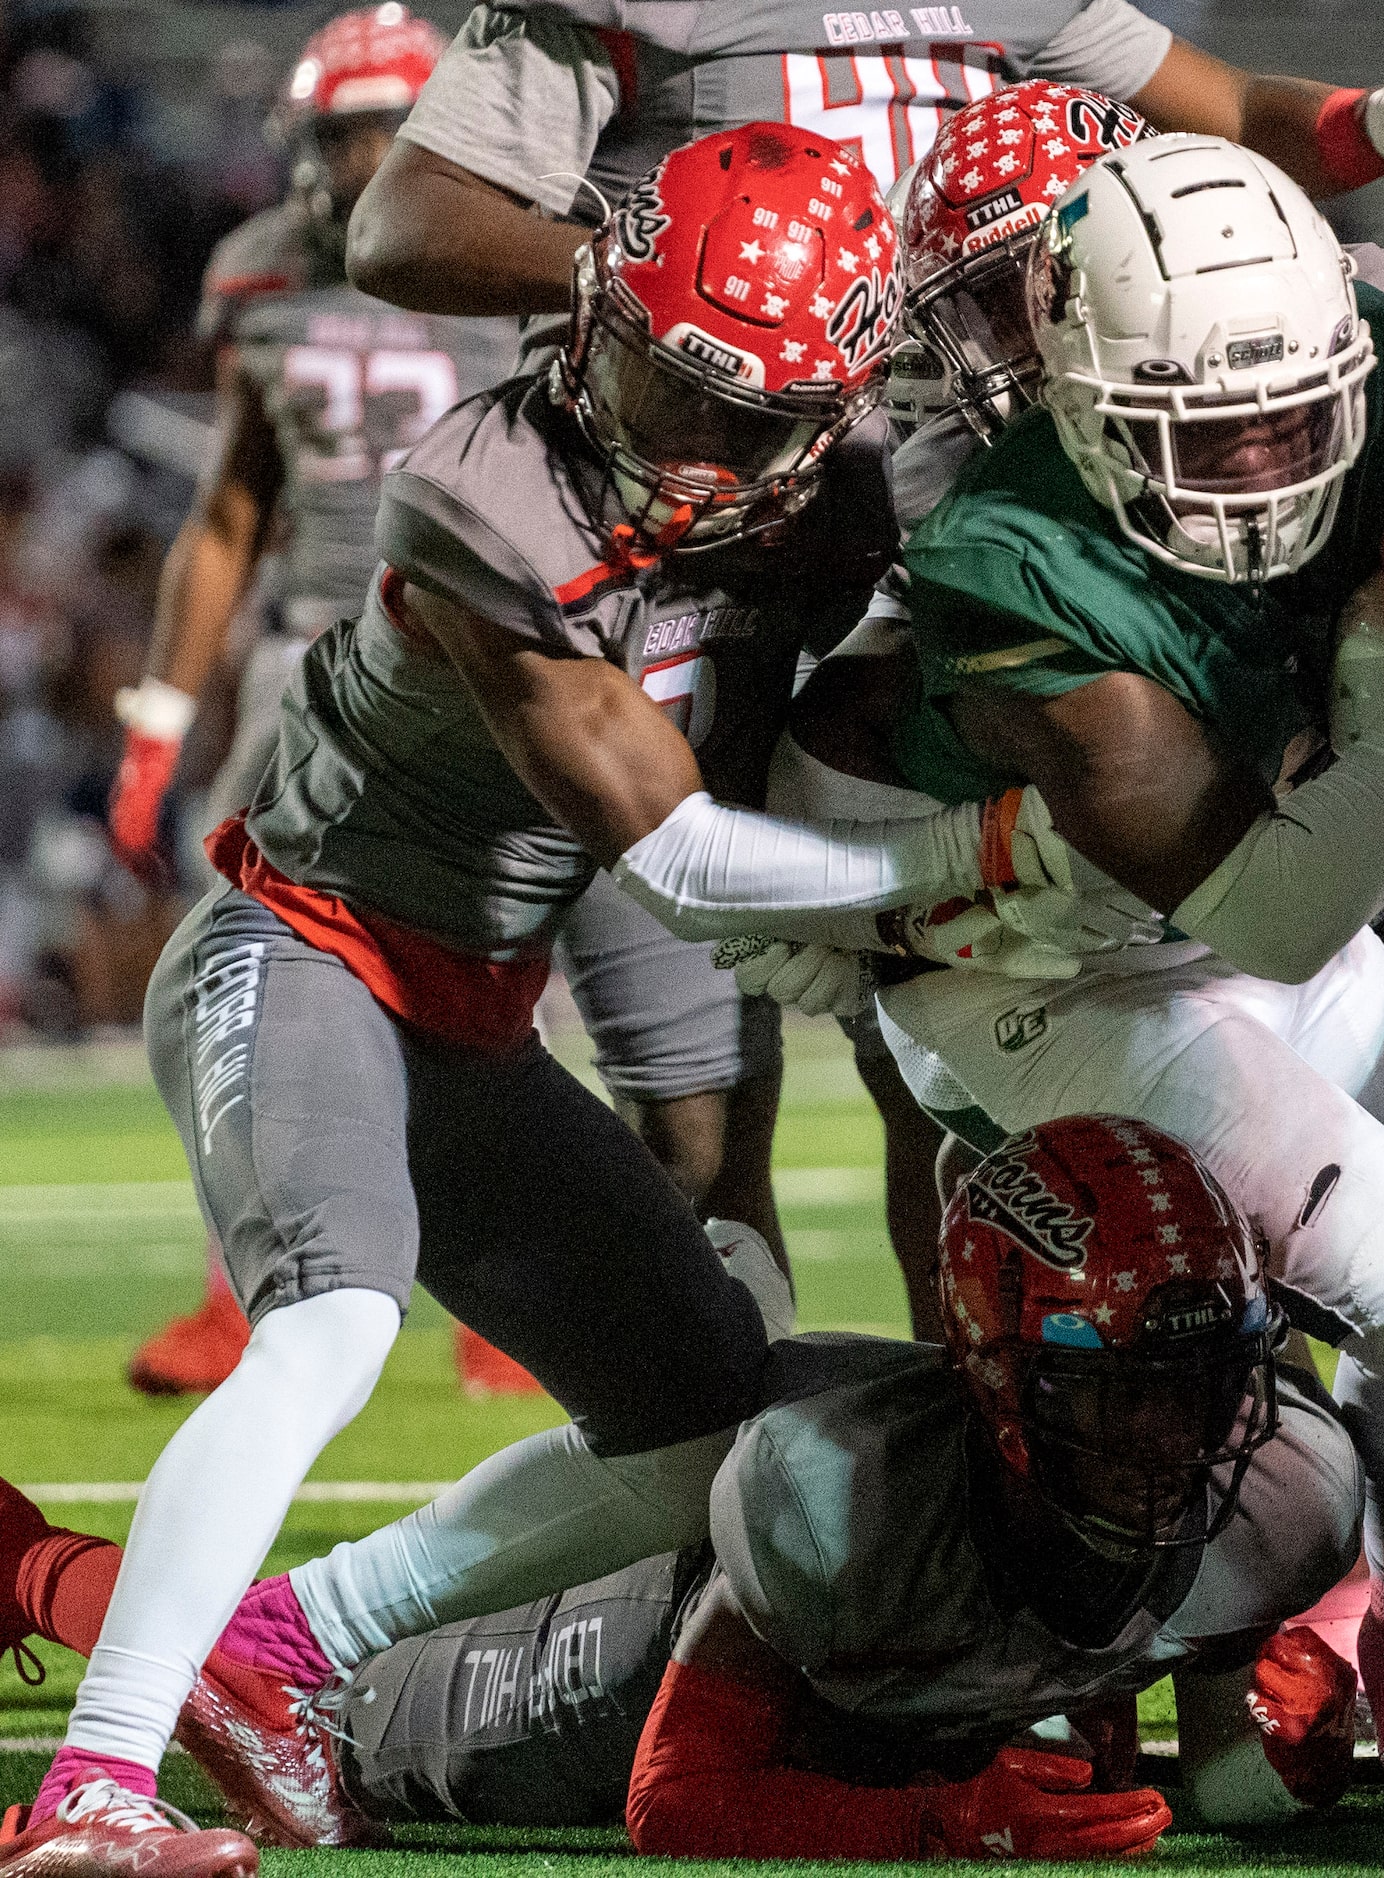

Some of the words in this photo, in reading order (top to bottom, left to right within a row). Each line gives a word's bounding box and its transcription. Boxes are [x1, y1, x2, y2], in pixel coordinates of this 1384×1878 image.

[823, 10, 910, 45] CEDAR
[909, 6, 974, 37] HILL
[820, 176, 844, 199] 911
[751, 207, 779, 230] 911
[807, 197, 833, 222] 911
[966, 194, 1022, 227] TTHL
[786, 220, 812, 245] 911
[966, 207, 1042, 254] Riddell
[723, 275, 751, 301] 911
[684, 333, 740, 376] TTHL
[195, 942, 264, 1067] CEDAR
[197, 1043, 248, 1156] HILL
[464, 1646, 525, 1733] HILL
